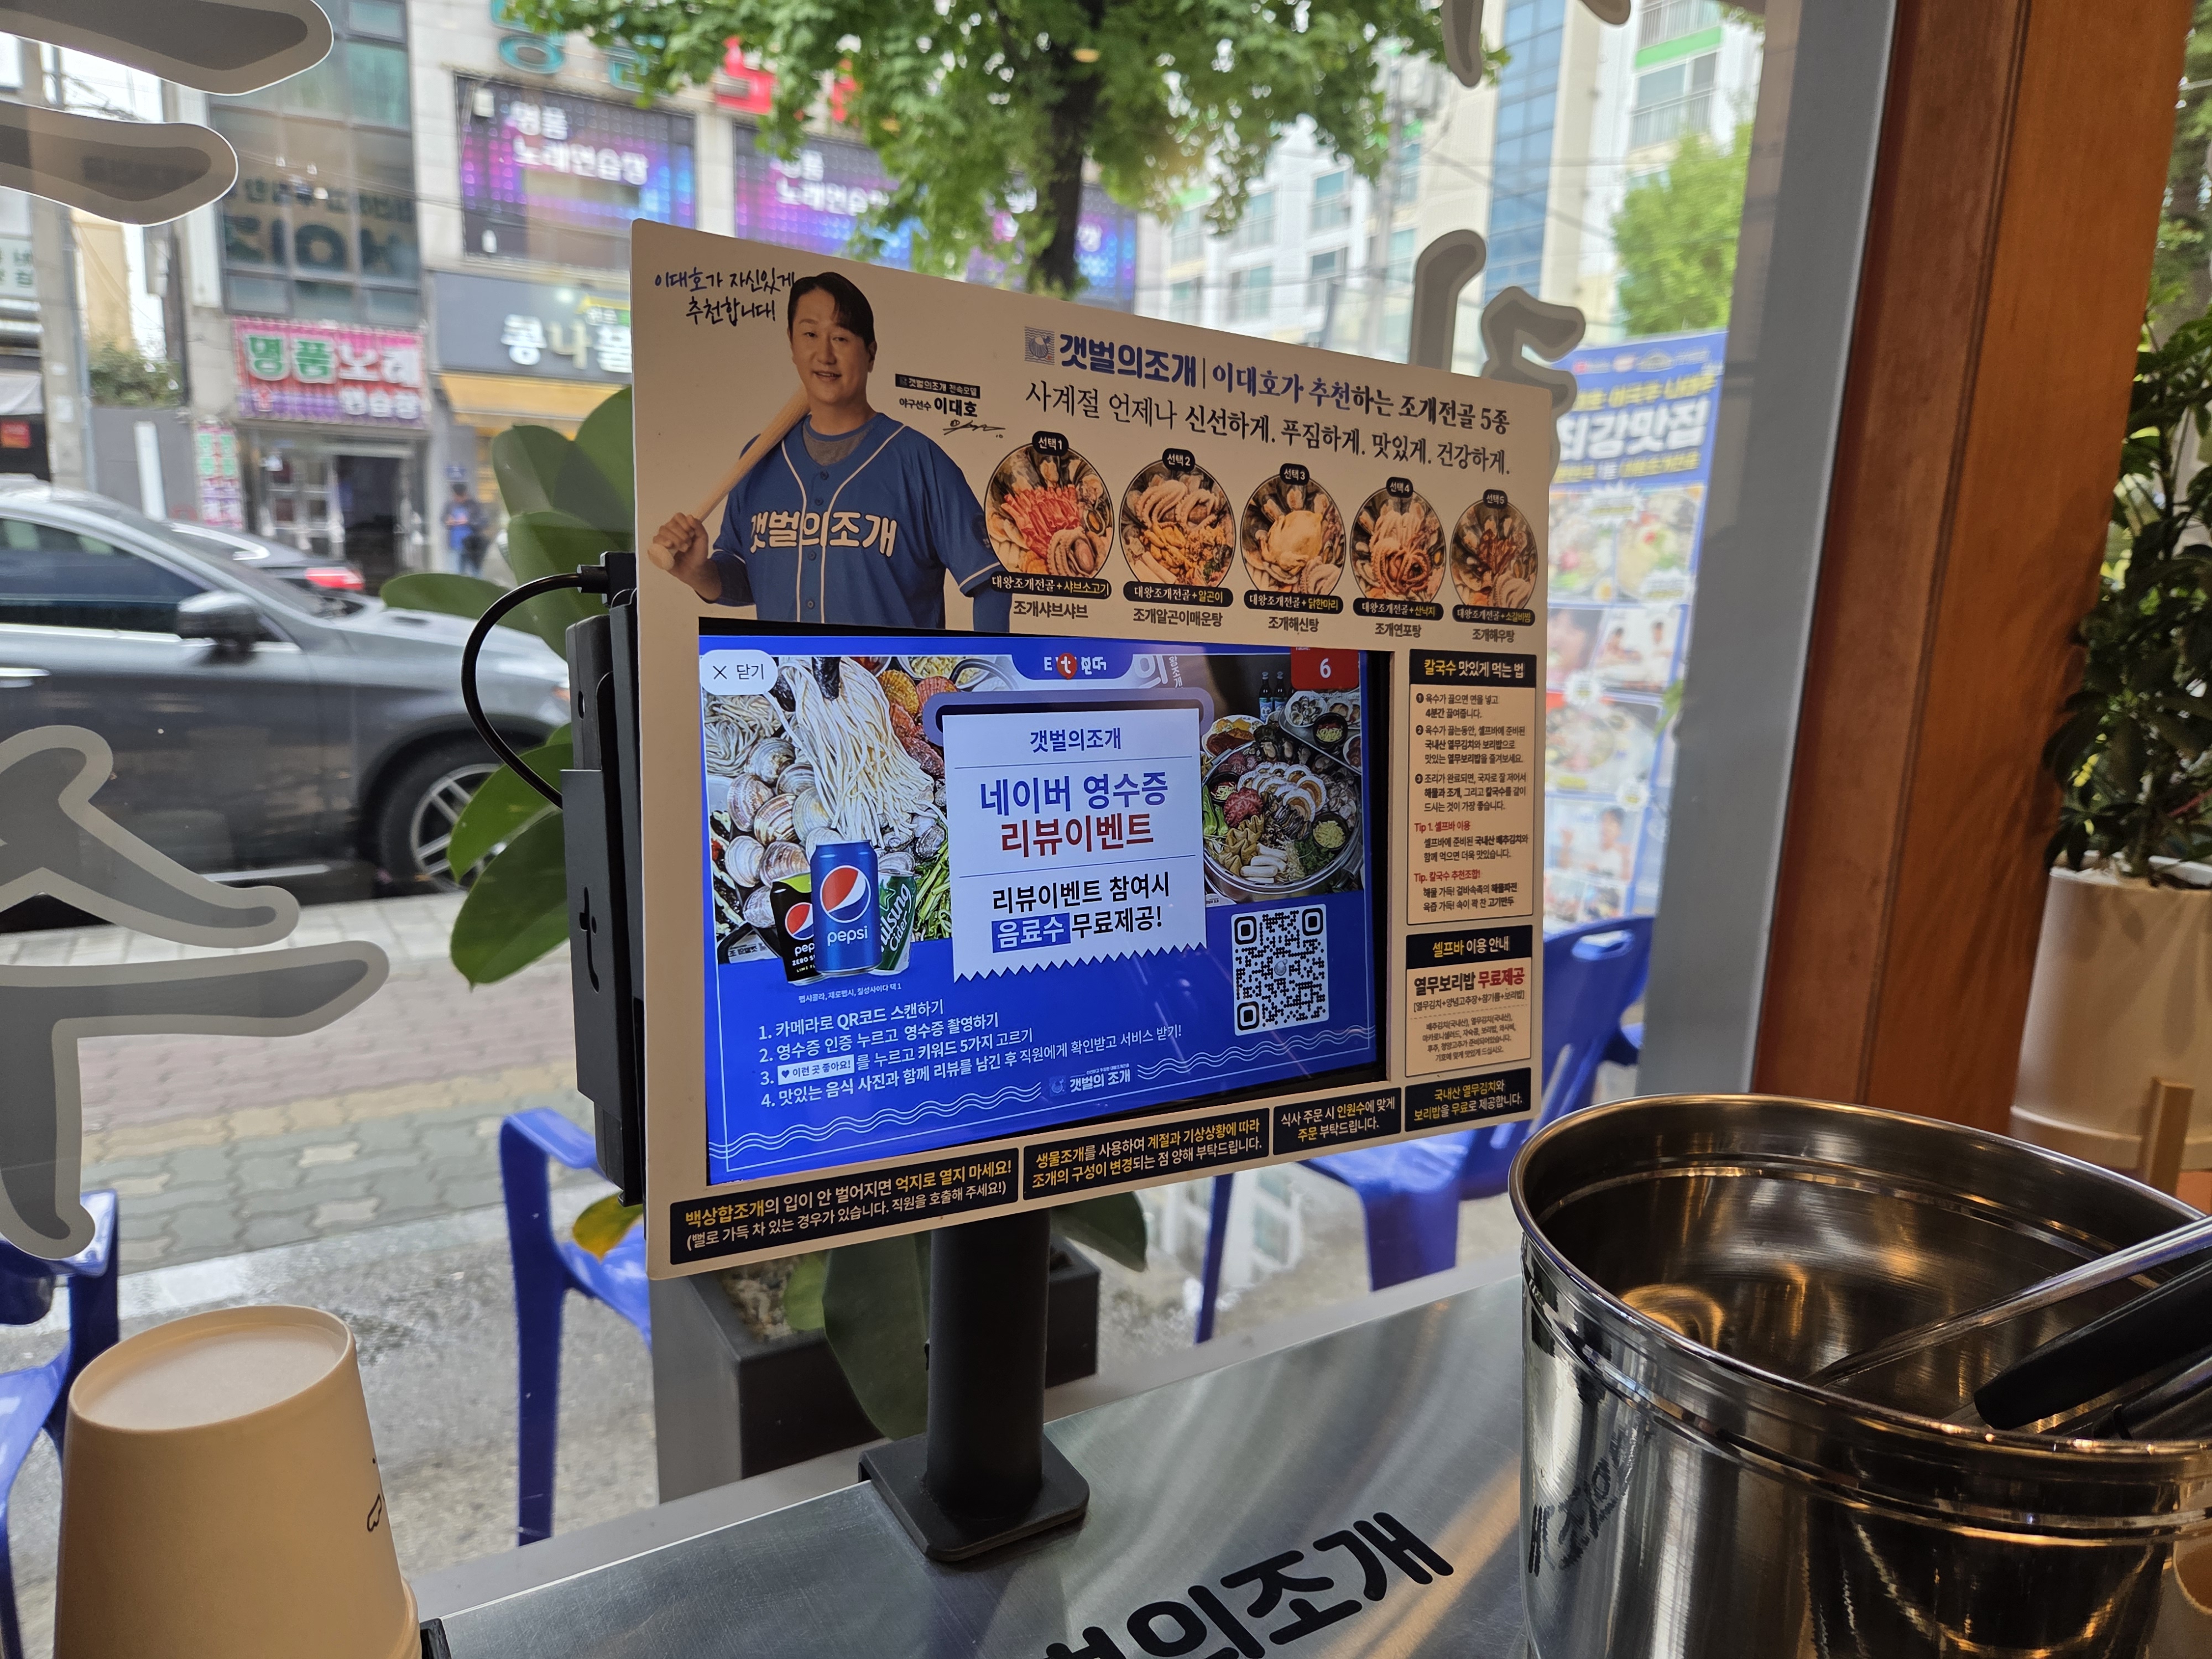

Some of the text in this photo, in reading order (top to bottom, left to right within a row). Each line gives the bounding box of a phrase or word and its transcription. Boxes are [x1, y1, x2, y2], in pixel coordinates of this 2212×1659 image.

[655, 267, 795, 294] 이대호가 자신있게
[686, 297, 775, 325] 추천합니다!
[909, 378, 947, 392] 갯벌의조개
[1060, 333, 1510, 435] 갯벌의조개 이대호가 추천하는 조개전골 5종
[899, 397, 978, 417] 야구선수 이대호
[1026, 380, 1101, 419] 사계절
[1109, 393, 1176, 430] 언제나
[1186, 403, 1275, 444] 신선하게.
[1281, 417, 1366, 456] 푸짐하게.
[1372, 432, 1432, 465] 맛있게.
[1437, 441, 1510, 476] 건강하게.
[1039, 437, 1062, 450] 선택1
[1167, 453, 1191, 466] 선택2
[1284, 469, 1306, 481] 선택3
[1390, 482, 1410, 493] 선택4
[750, 510, 897, 557] 갯벌의조개
[1014, 600, 1515, 643] 조개샤브샤브 조개알곤이매운탕 조개해신탕 조개연포탕 조개해우탕
[737, 664, 765, 680] 닫기
[1319, 658, 1331, 679] 6
[1424, 659, 1524, 679] 칼국수 맛있게 먹는 법
[1426, 693, 1447, 704] 육수가
[1030, 727, 1121, 753] 갯벌의조개
[980, 771, 1168, 816] 네이버 영수증
[1424, 801, 1505, 812] 드시는 것이 가장 좋습니다.
[1001, 812, 1154, 858] 리뷰이벤트
[1415, 821, 1470, 833] Tip 1. 셀프바 이용
[1414, 869, 1480, 883] Tip. 칼국수 추천조합!
[993, 872, 1170, 914] 리뷰이벤트 참여시
[827, 925, 868, 947] pepsi
[890, 910, 907, 952] Cider
[997, 906, 1162, 949] 음료수 무료제공!
[1433, 936, 1509, 958] 셀프바 이용 안내
[1414, 967, 1525, 996] 열무보리밥 무료제공
[759, 998, 944, 1041] 1. 카메라로 QR코드 스캔하기
[759, 1011, 998, 1063] 2. 영수증 인증 누르고 영수증 촬영하기
[760, 1028, 1032, 1086] 3. 이런 곳 좋아요! 를 누르고 키워드 5가지 고르기
[761, 1024, 1182, 1108] 4. 맛있는 음식 사진과 함께 리뷰를 남긴 후 직원에게 확인받고 서비스 받기!
[1070, 1073, 1104, 1093] 갯벌의
[1108, 1069, 1130, 1085] 조개
[1434, 1079, 1505, 1102] 국내산 열무김치와
[1281, 1096, 1395, 1127] 식사 주문 시 인원수에 맞게
[1414, 1092, 1522, 1121] 보리밥을 무료로 제공합니다.
[1036, 1118, 1260, 1169] 생물조개를 사용하여 계절과 기상상황에 따라
[1297, 1118, 1379, 1142] 주문 부탁드립니다.
[1032, 1138, 1262, 1188] 조개의 구성이 변경되는 점 양해 부탁드립니다.
[685, 1160, 1011, 1228] 백상합조개의 입이 안 벌어지면 억지로 열지 마세요!
[686, 1181, 1007, 1251] (뻘로 가득 차 있는 경우가 있습니다. 직원을 호출해 주세요!)
